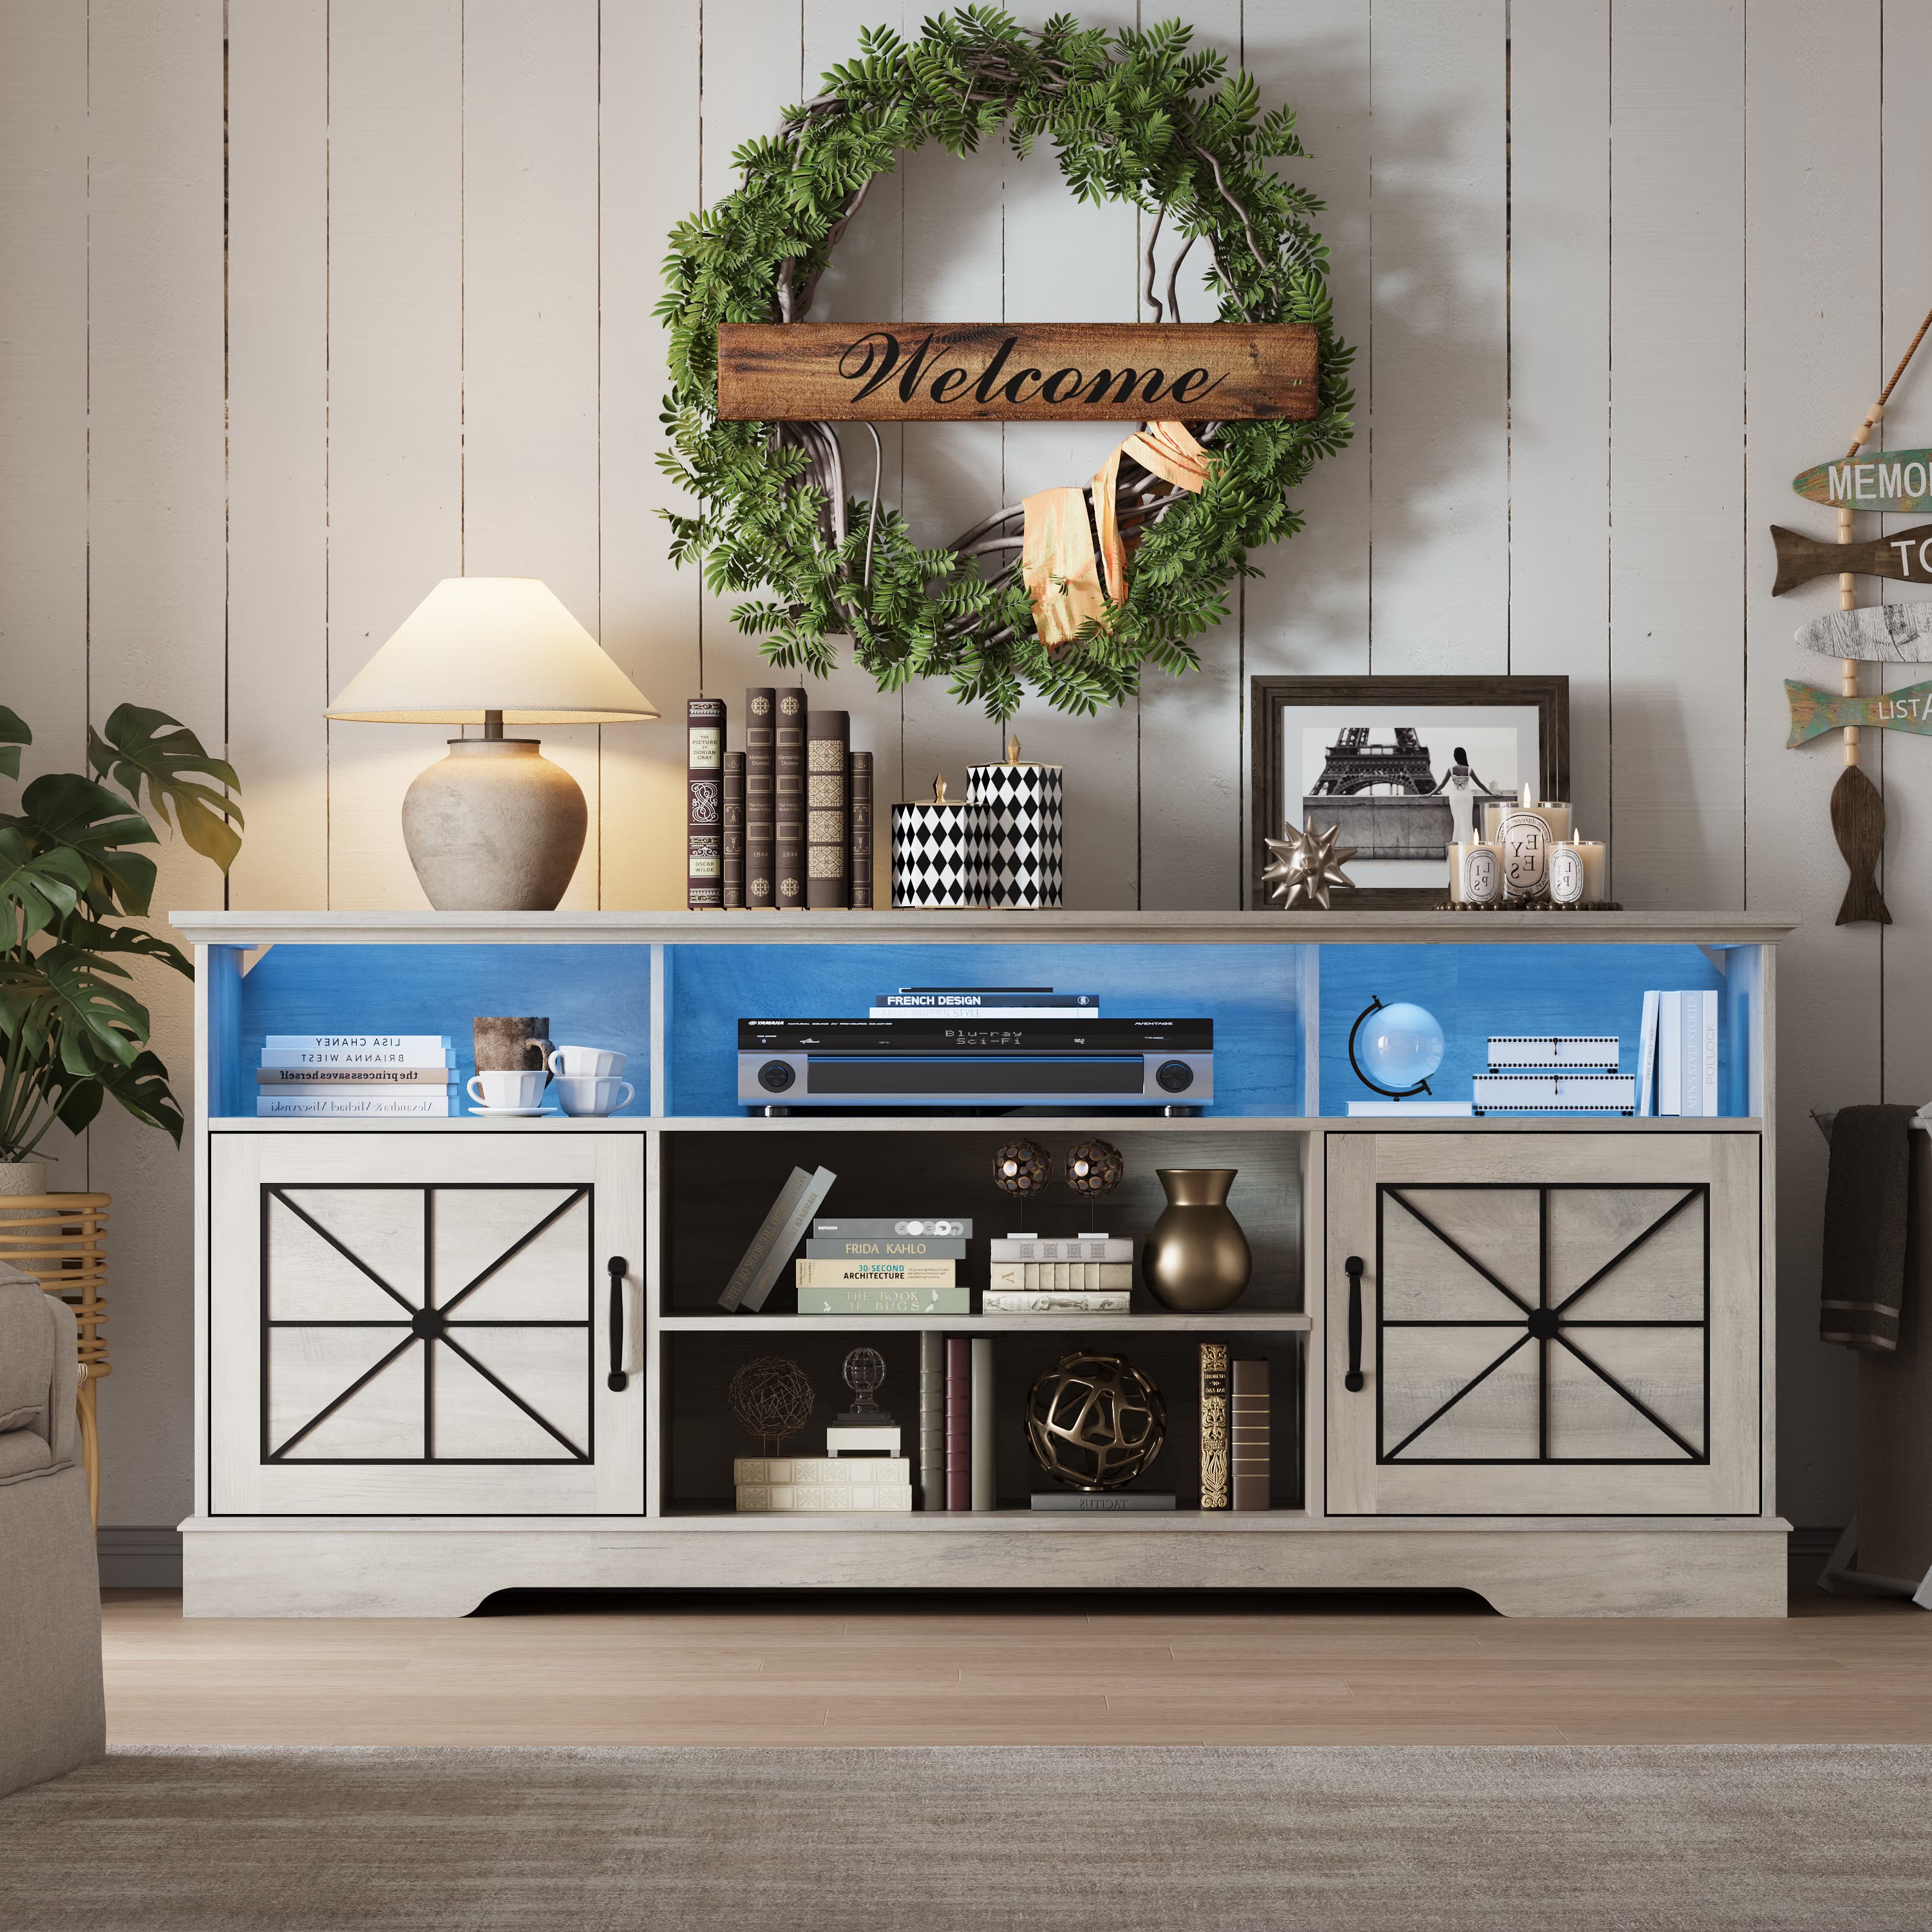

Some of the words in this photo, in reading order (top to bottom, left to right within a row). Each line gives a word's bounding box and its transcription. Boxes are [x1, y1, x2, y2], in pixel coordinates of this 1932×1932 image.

[838, 332, 1231, 405] Welcome
[1828, 462, 1932, 500] MEMO
[1879, 699, 1920, 720] LIST
[887, 996, 934, 1005] FRENCH
[938, 996, 981, 1005] DESIGN
[1706, 1023, 1715, 1084] POLLOCK
[846, 1244, 879, 1254] FRIDA
[886, 1244, 926, 1254] KAHLO
[844, 1291, 871, 1301] THE
[880, 1291, 918, 1301] BOOK
[876, 1302, 920, 1311] BUGS
